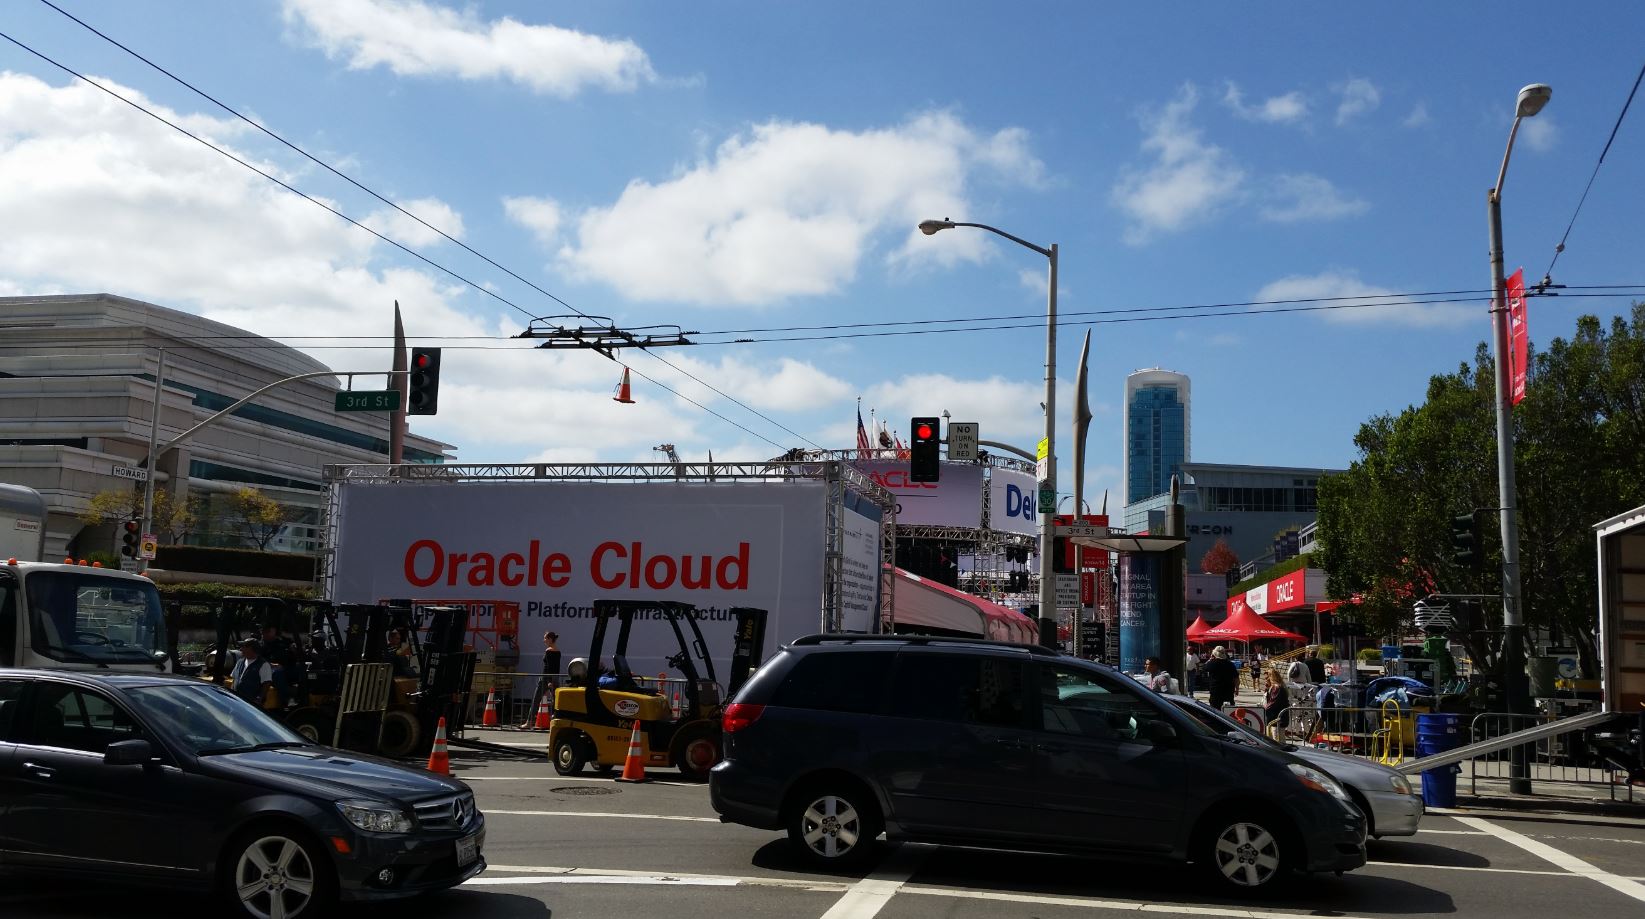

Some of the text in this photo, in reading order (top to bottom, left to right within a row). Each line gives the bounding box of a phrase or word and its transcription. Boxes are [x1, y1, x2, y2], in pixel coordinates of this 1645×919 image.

[346, 396, 389, 407] 3rd St
[115, 468, 146, 480] HOWARD
[1007, 484, 1037, 523] Del
[1067, 527, 1080, 535] 3rd
[405, 541, 749, 589] Oracle Cloud
[1276, 580, 1294, 603] ORACLE
[743, 618, 753, 640] Yale
